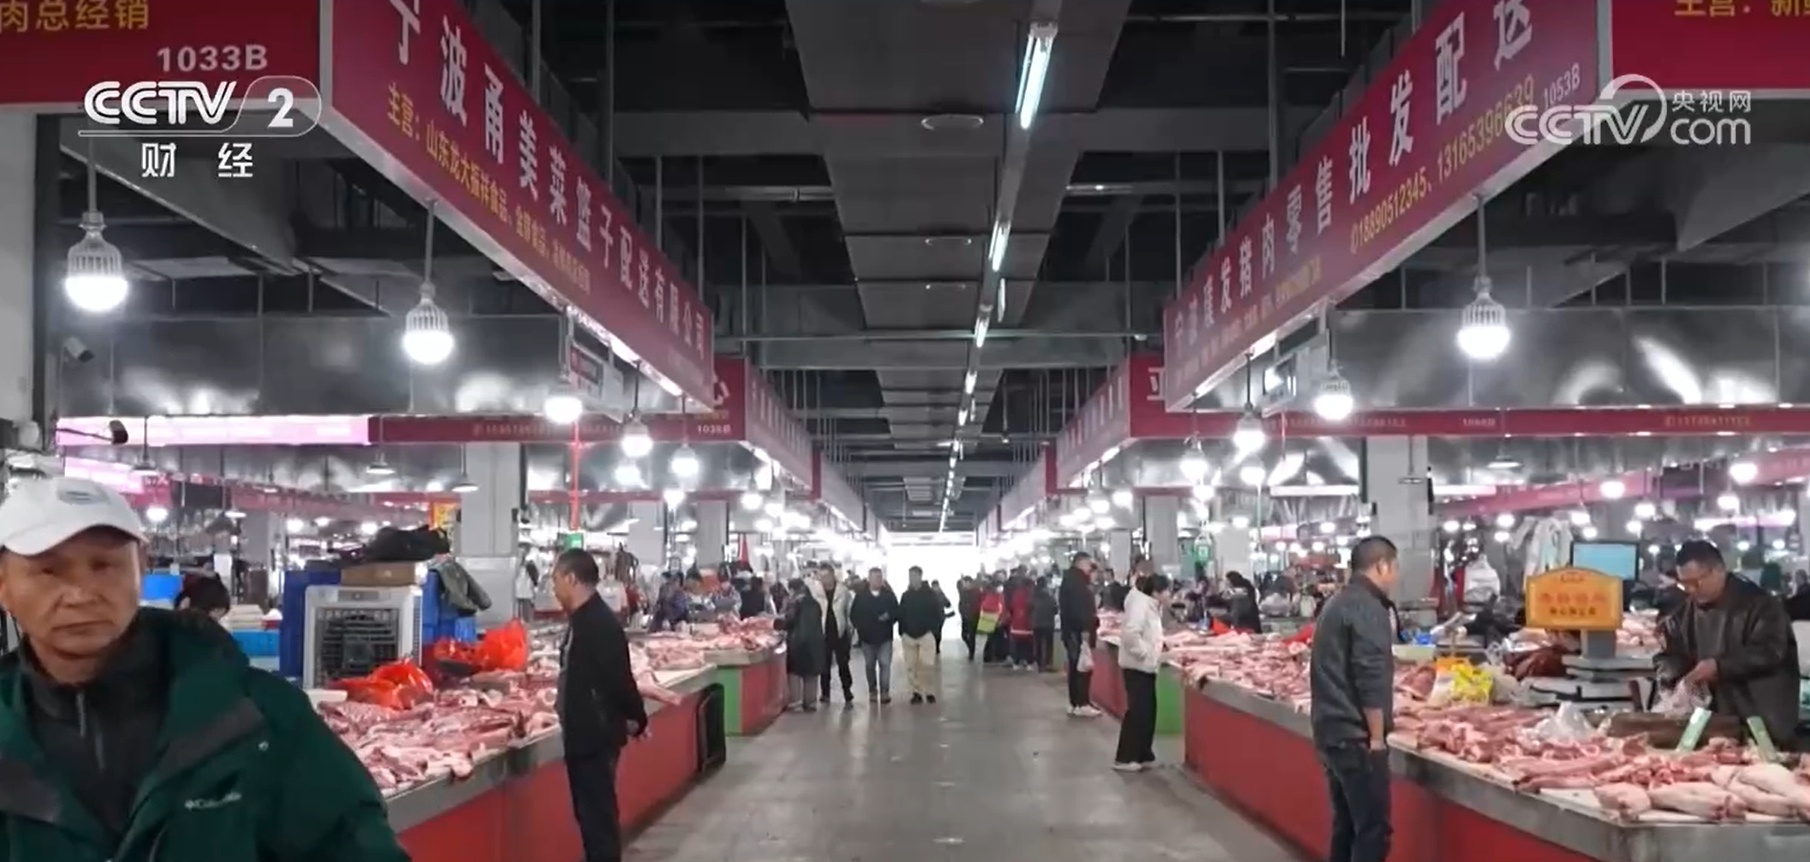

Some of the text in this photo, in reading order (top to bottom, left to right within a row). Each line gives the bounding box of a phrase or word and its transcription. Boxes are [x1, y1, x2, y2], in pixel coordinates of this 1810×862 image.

[0, 0, 150, 33] 肉总经销
[157, 44, 268, 72] 1033B
